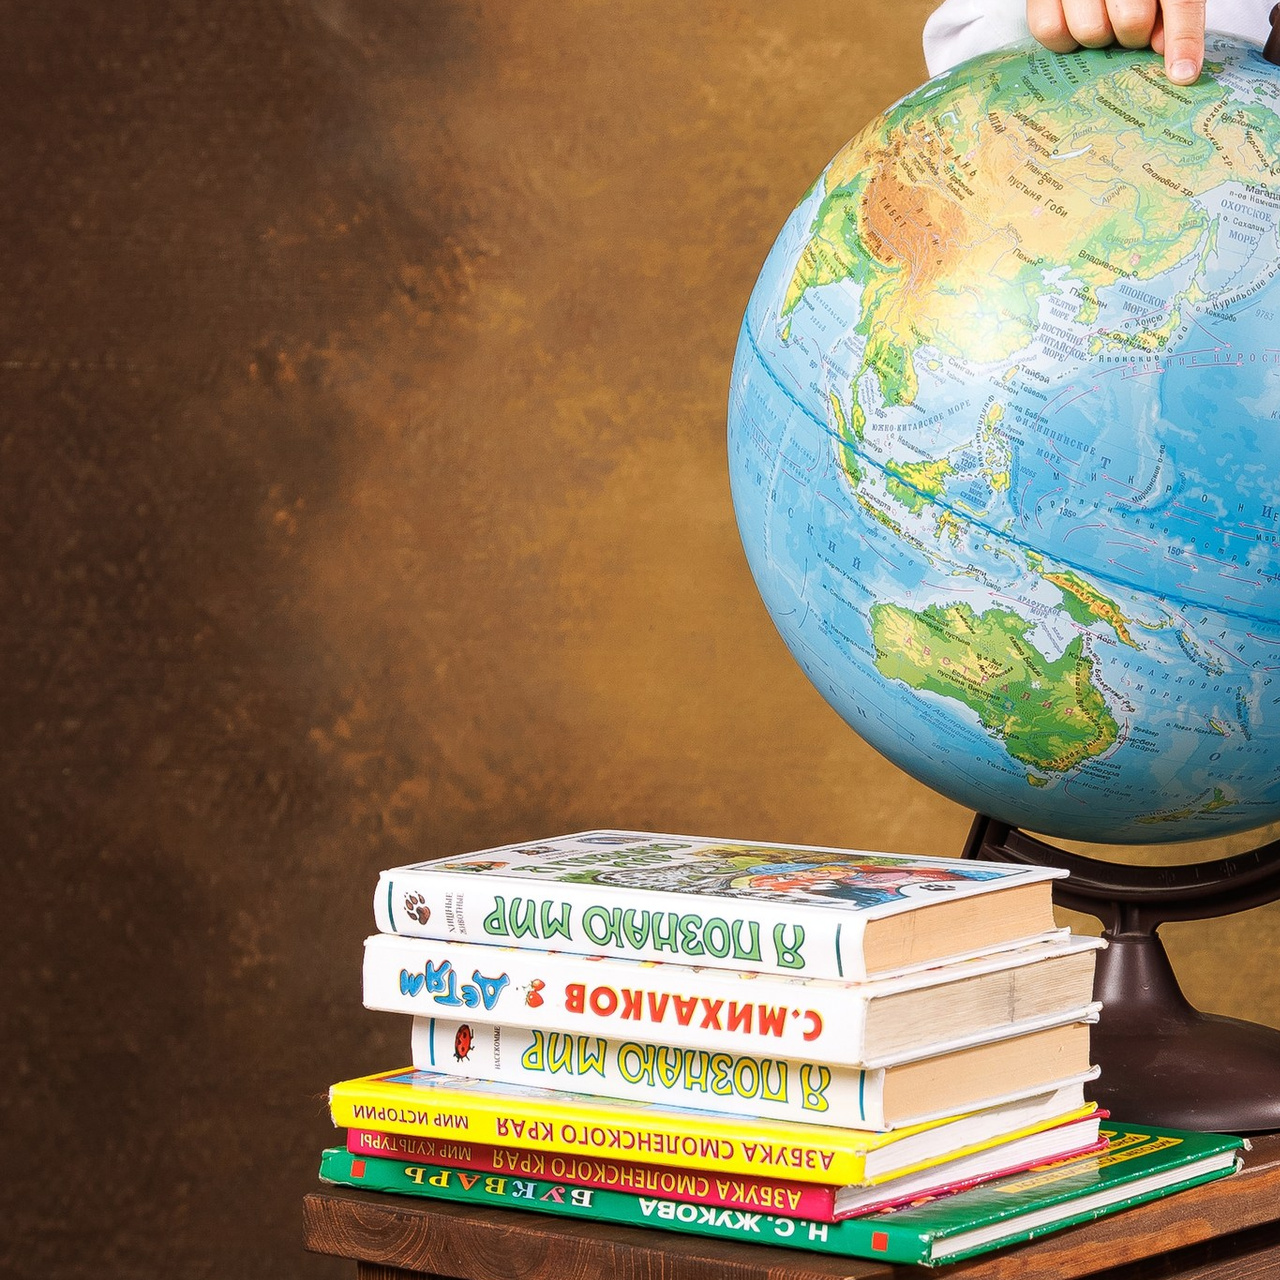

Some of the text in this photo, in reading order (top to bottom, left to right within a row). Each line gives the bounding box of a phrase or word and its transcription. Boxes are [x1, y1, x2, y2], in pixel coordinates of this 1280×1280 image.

[881, 197, 907, 228] ТИБЕТ
[1007, 175, 1068, 218] пустыня Гоби
[1221, 198, 1271, 221] ОХОТСКОЕ
[1228, 229, 1256, 246] МОРЕ
[1232, 216, 1265, 233] Сахалин
[1078, 249, 1132, 280] Владивосток
[1069, 287, 1108, 309] Пхеньян
[1119, 284, 1167, 308] ЯПОНСКОЕ
[905, 637, 1074, 716] АВСТРАЛИЯ
[1110, 658, 1232, 694] КОРАЛЛОВОЕ
[1135, 683, 1183, 702] МОРЕ
[482, 895, 806, 970] Я ПОЗНАЮ МИР
[521, 1030, 832, 1113] Я ПОЗНАЮ МИР
[352, 1104, 836, 1171] АЗБУКА СМОЛЕНСКОГО КРАЯ МИР ИСТОРИИ
[360, 1133, 802, 1211] АЗБУКА СМОЛЕНСКОГО КРАЯ МИР КУЛЬТУРЫ
[404, 1166, 828, 1243] Н. С. ЖУКОВА БУКВАРЬ
